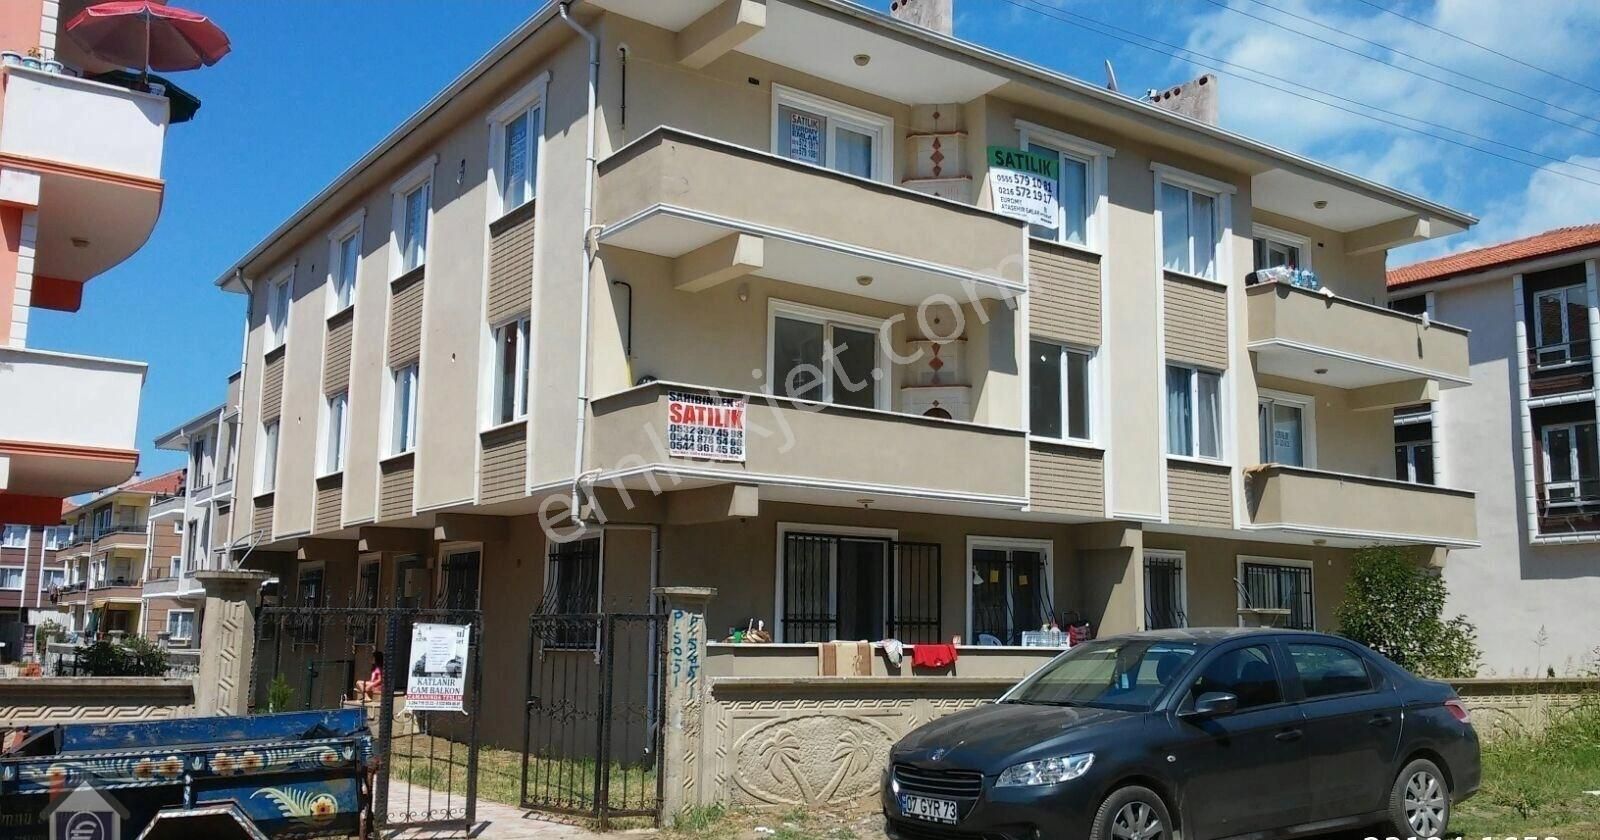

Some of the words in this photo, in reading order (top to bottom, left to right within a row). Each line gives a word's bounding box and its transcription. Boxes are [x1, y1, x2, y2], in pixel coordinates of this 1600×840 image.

[994, 150, 1051, 177] SATILIK
[1014, 174, 1030, 186] 579
[1032, 177, 1042, 189] 10
[1015, 186, 1031, 199] 572
[1033, 190, 1042, 202] 19
[1044, 193, 1052, 204] 17
[670, 403, 743, 430] SATILIK
[670, 424, 696, 434] 0532
[716, 428, 729, 438] 45
[670, 432, 696, 443] 0544
[716, 436, 728, 446] 54
[670, 442, 696, 451] 0544
[697, 444, 714, 453] 961
[716, 446, 728, 454] 45
[730, 446, 742, 456] 65
[417, 678, 456, 687] KATLANIR
[411, 686, 428, 694] CAM
[430, 686, 460, 695] BALKON
[907, 796, 918, 812] 07
[920, 798, 940, 817] GYR
[944, 802, 956, 819] 73
